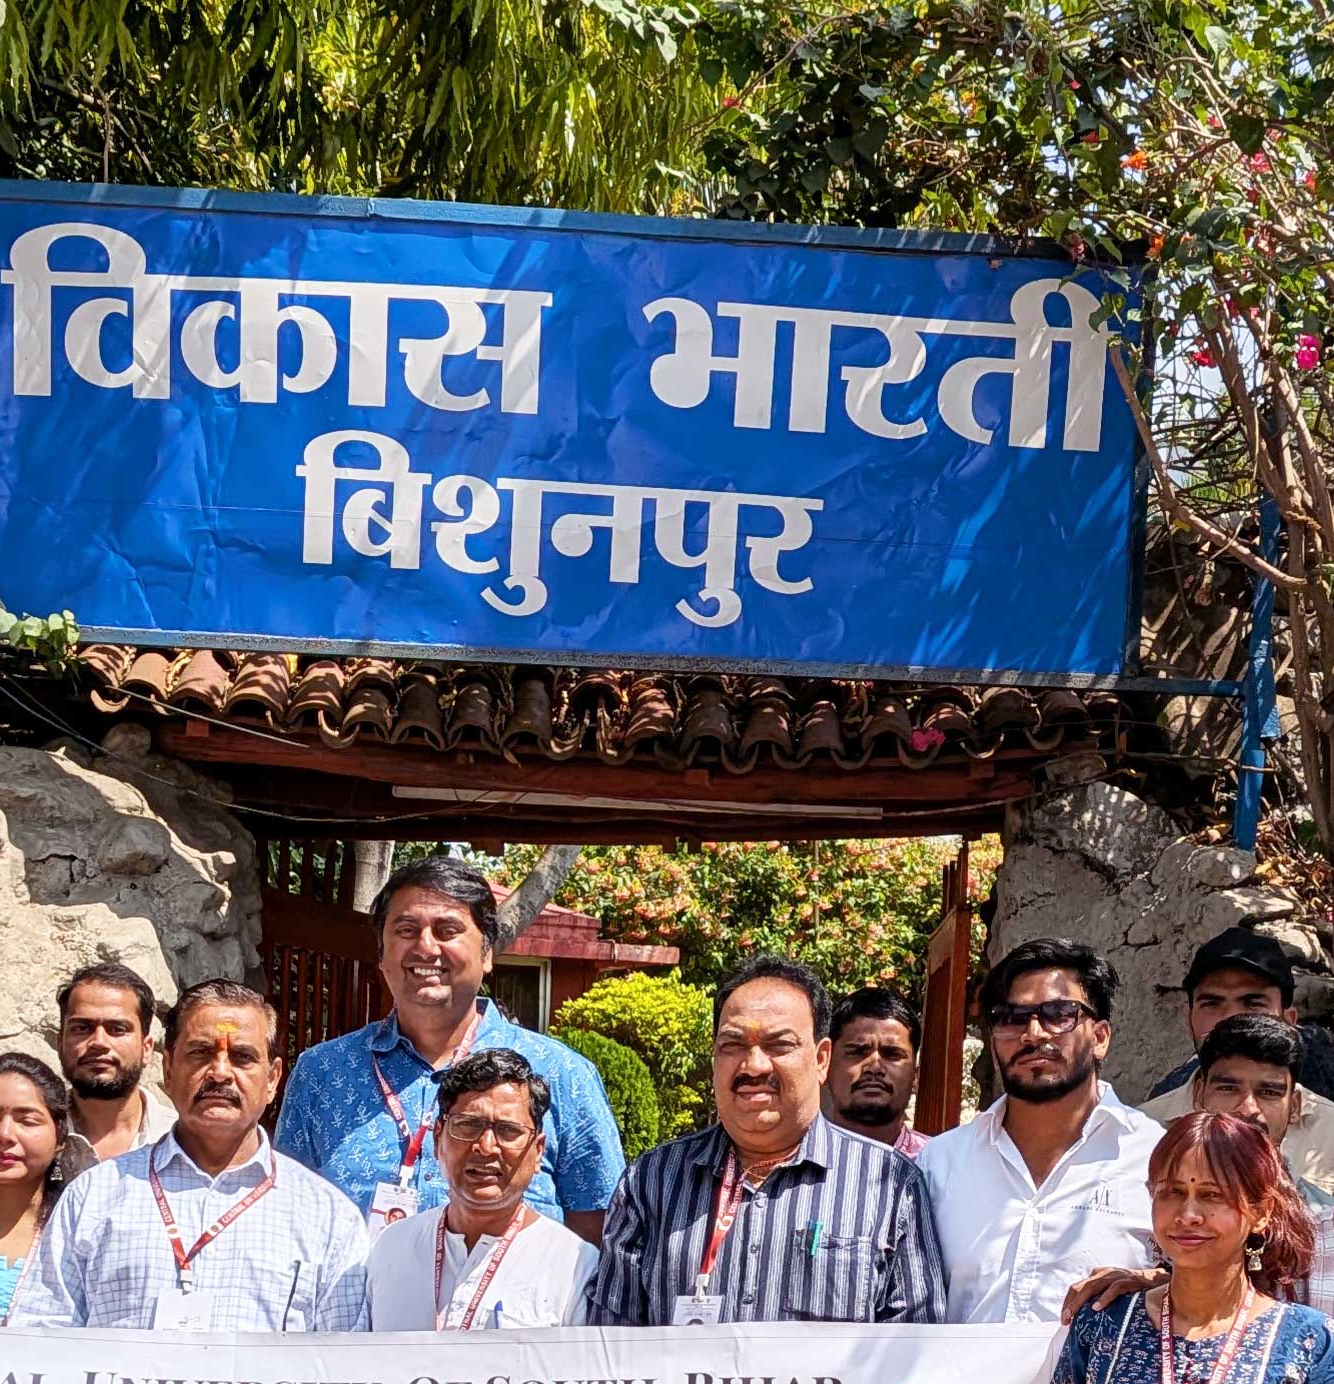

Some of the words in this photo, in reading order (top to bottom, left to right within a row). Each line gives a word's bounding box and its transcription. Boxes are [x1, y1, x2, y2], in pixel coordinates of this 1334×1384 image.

[0, 221, 554, 414] विकास
[642, 277, 1110, 452] भारती
[296, 429, 823, 628] बिशुनपुर
[1160, 1315, 1170, 1339] SOUTH
[1161, 1340, 1170, 1349] OF
